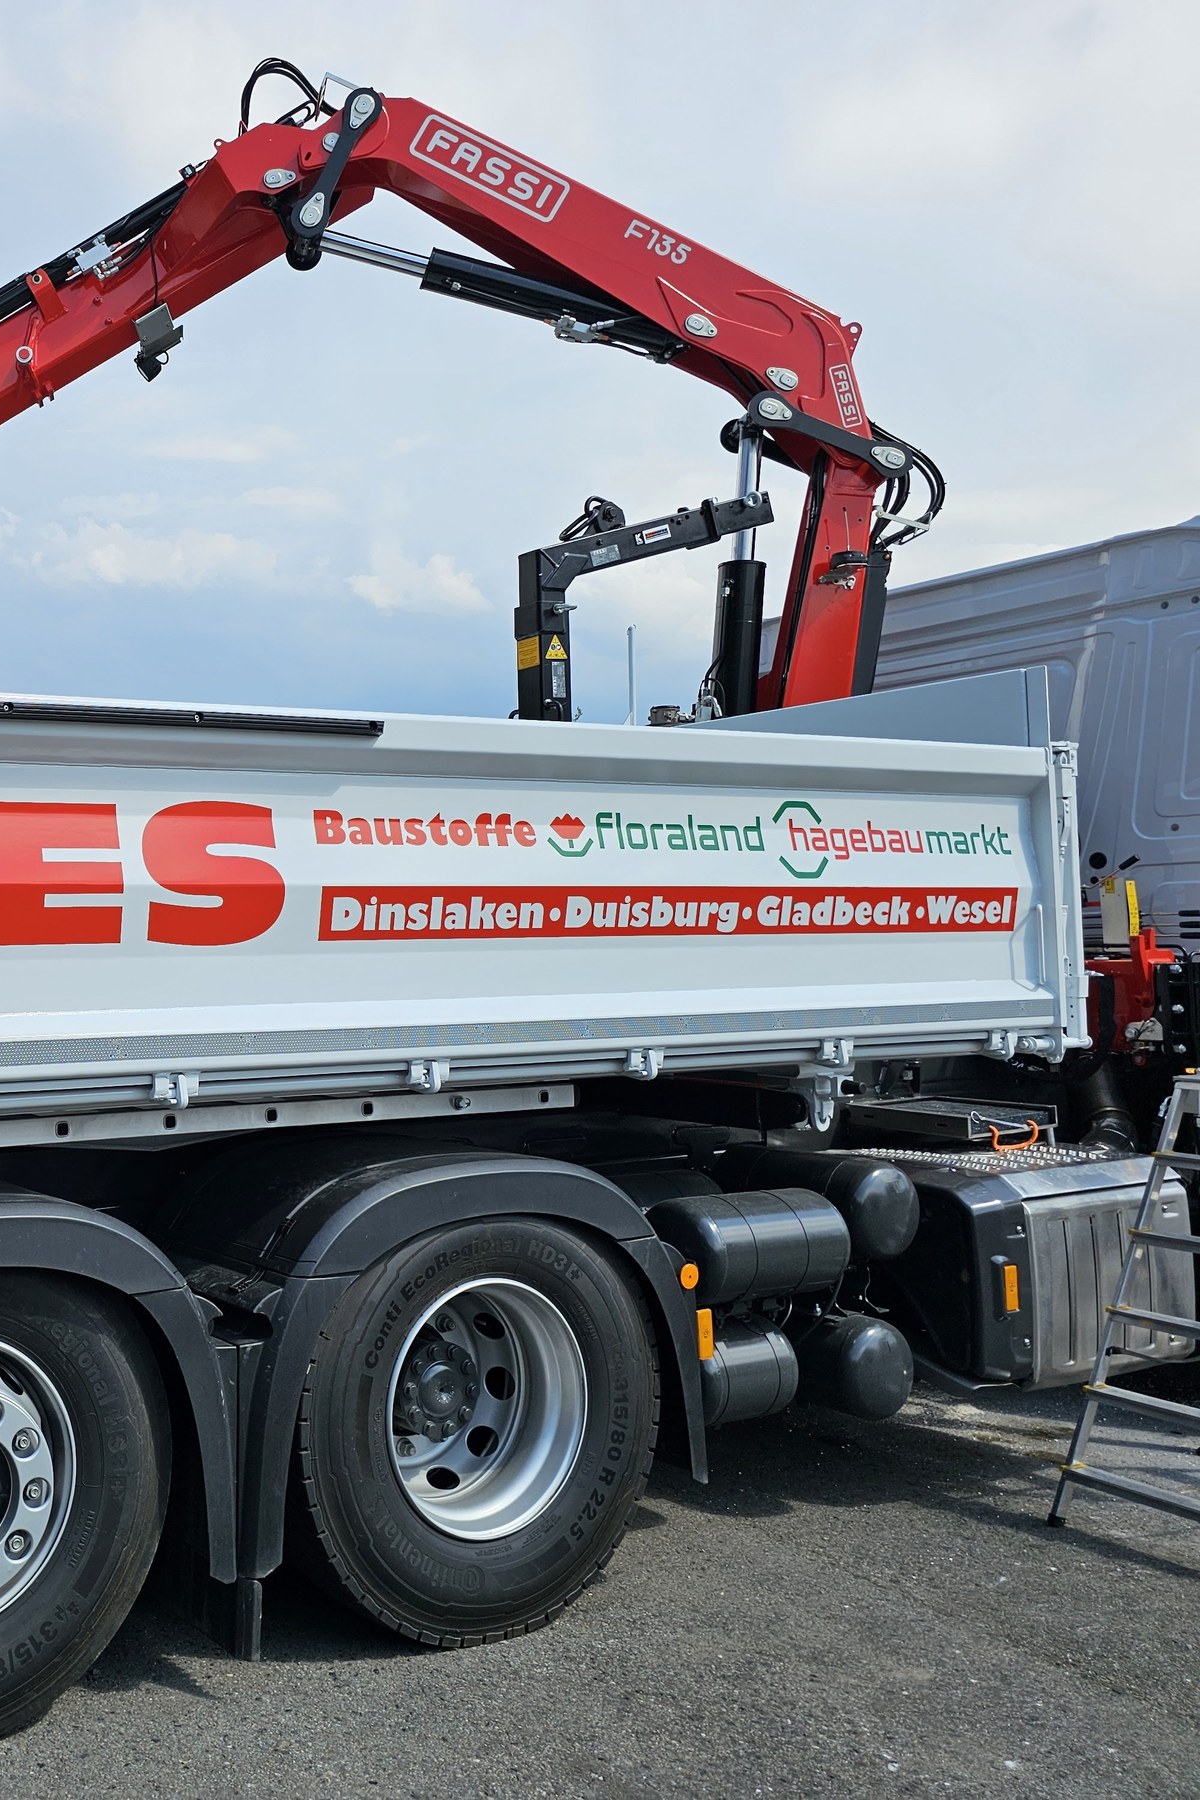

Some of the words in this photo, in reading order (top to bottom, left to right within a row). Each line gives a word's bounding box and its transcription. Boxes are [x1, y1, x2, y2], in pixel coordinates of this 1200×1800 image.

[426, 128, 554, 209] FASSI
[623, 218, 693, 266] F135
[833, 370, 858, 422] FASSI
[312, 808, 538, 849] Baustoffe
[595, 811, 766, 852] floraland
[788, 818, 1012, 861] hagebaumarkt
[329, 896, 545, 933] Dinslaken
[563, 895, 740, 934] Duisburg
[757, 894, 911, 927] Gladbeck
[926, 895, 1013, 925] Wesel
[365, 1299, 402, 1369] Conti
[605, 1376, 629, 1462] 315/80
[599, 1466, 617, 1487] R
[569, 1487, 606, 1542] 22.5
